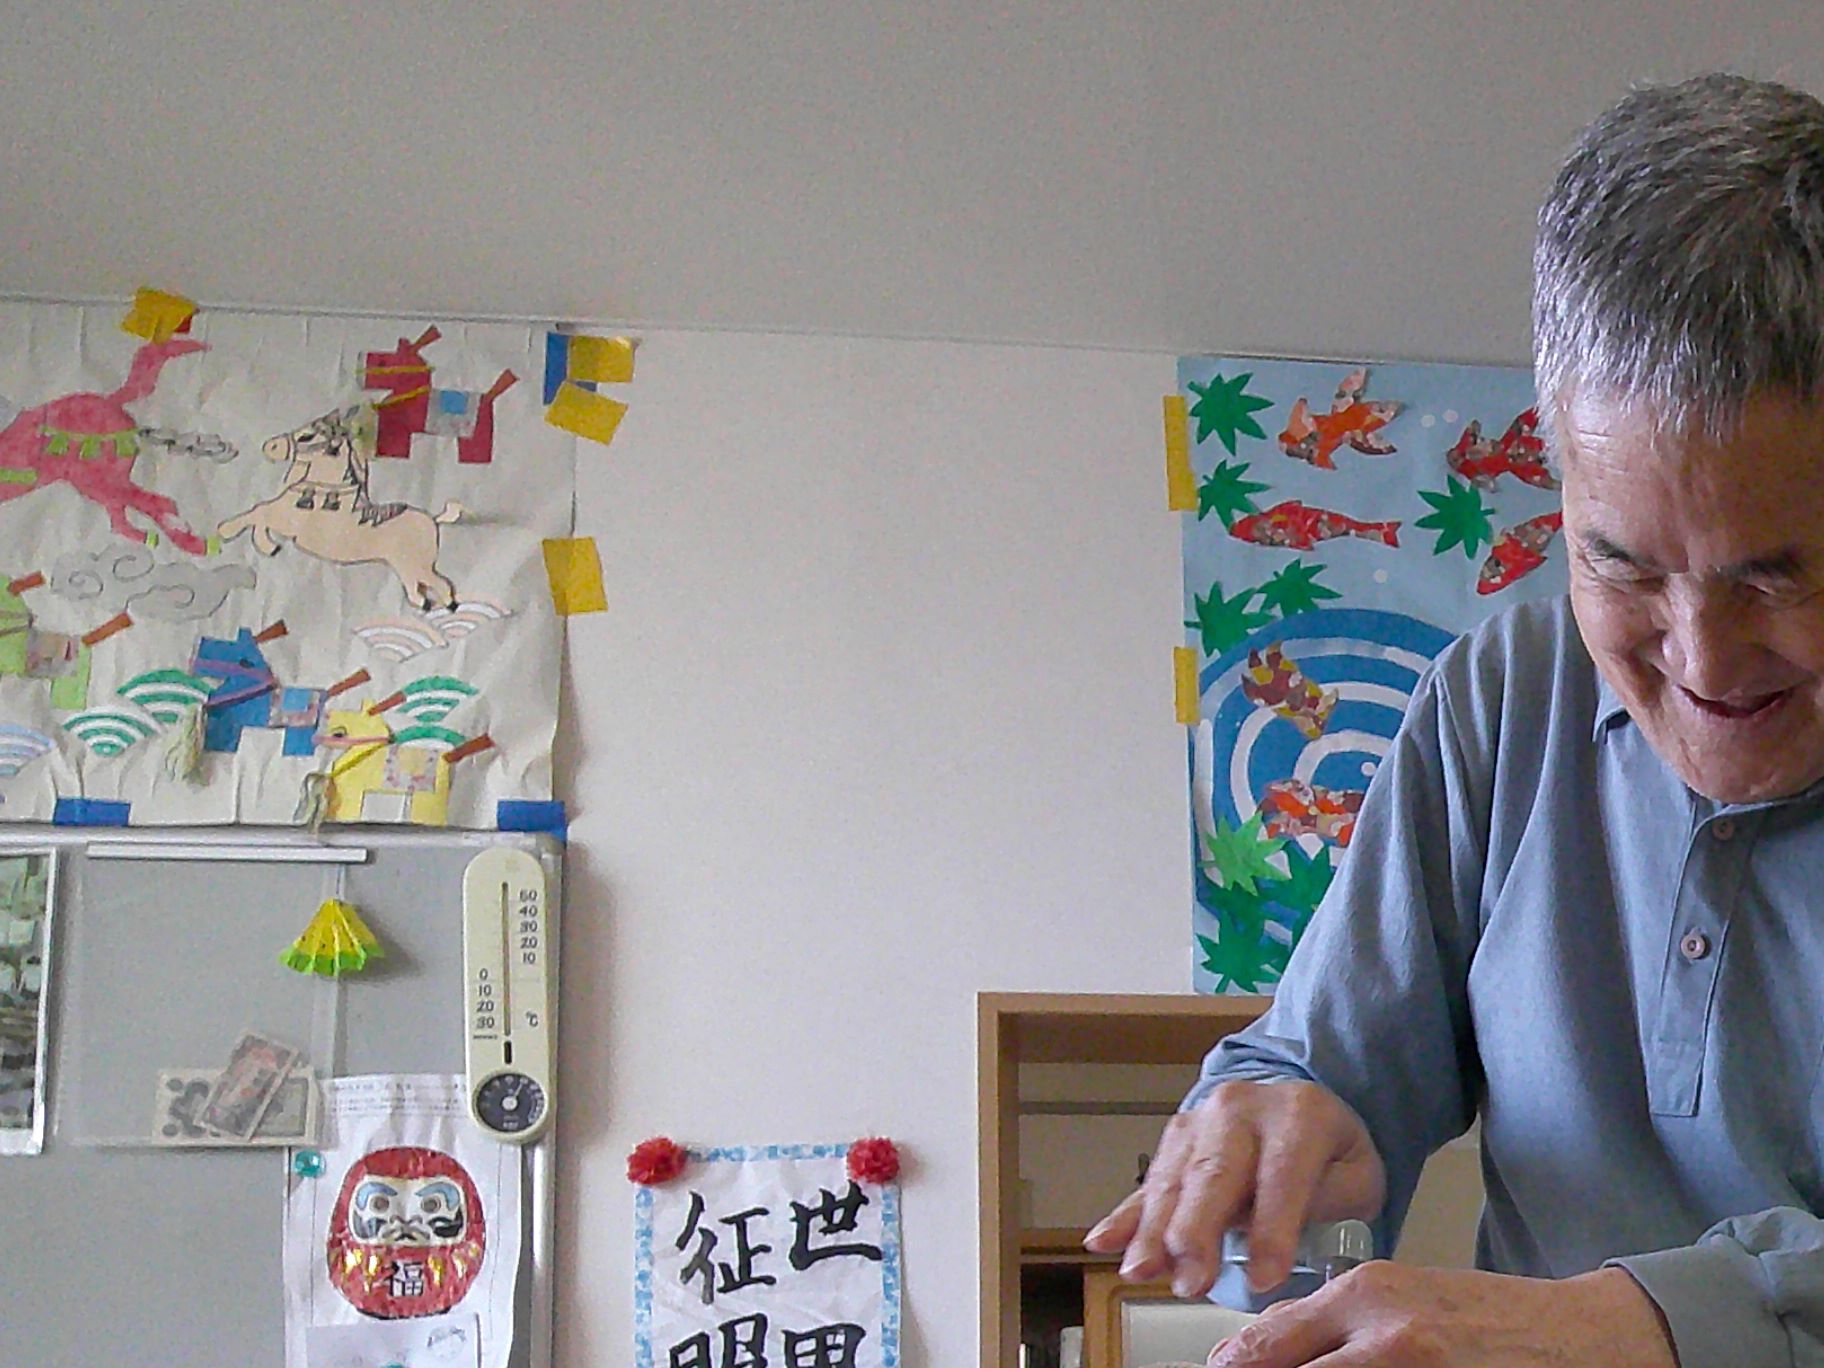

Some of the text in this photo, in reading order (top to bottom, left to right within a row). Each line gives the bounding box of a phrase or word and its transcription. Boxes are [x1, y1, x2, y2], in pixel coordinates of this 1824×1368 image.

[519, 905, 538, 918] 40
[520, 920, 538, 933] 30
[520, 936, 538, 949] 20
[523, 952, 536, 965] 10
[479, 967, 488, 981] 0
[479, 984, 492, 997] 10
[477, 1000, 494, 1013] 20
[476, 1016, 495, 1029] 30
[384, 1260, 424, 1297] 福
